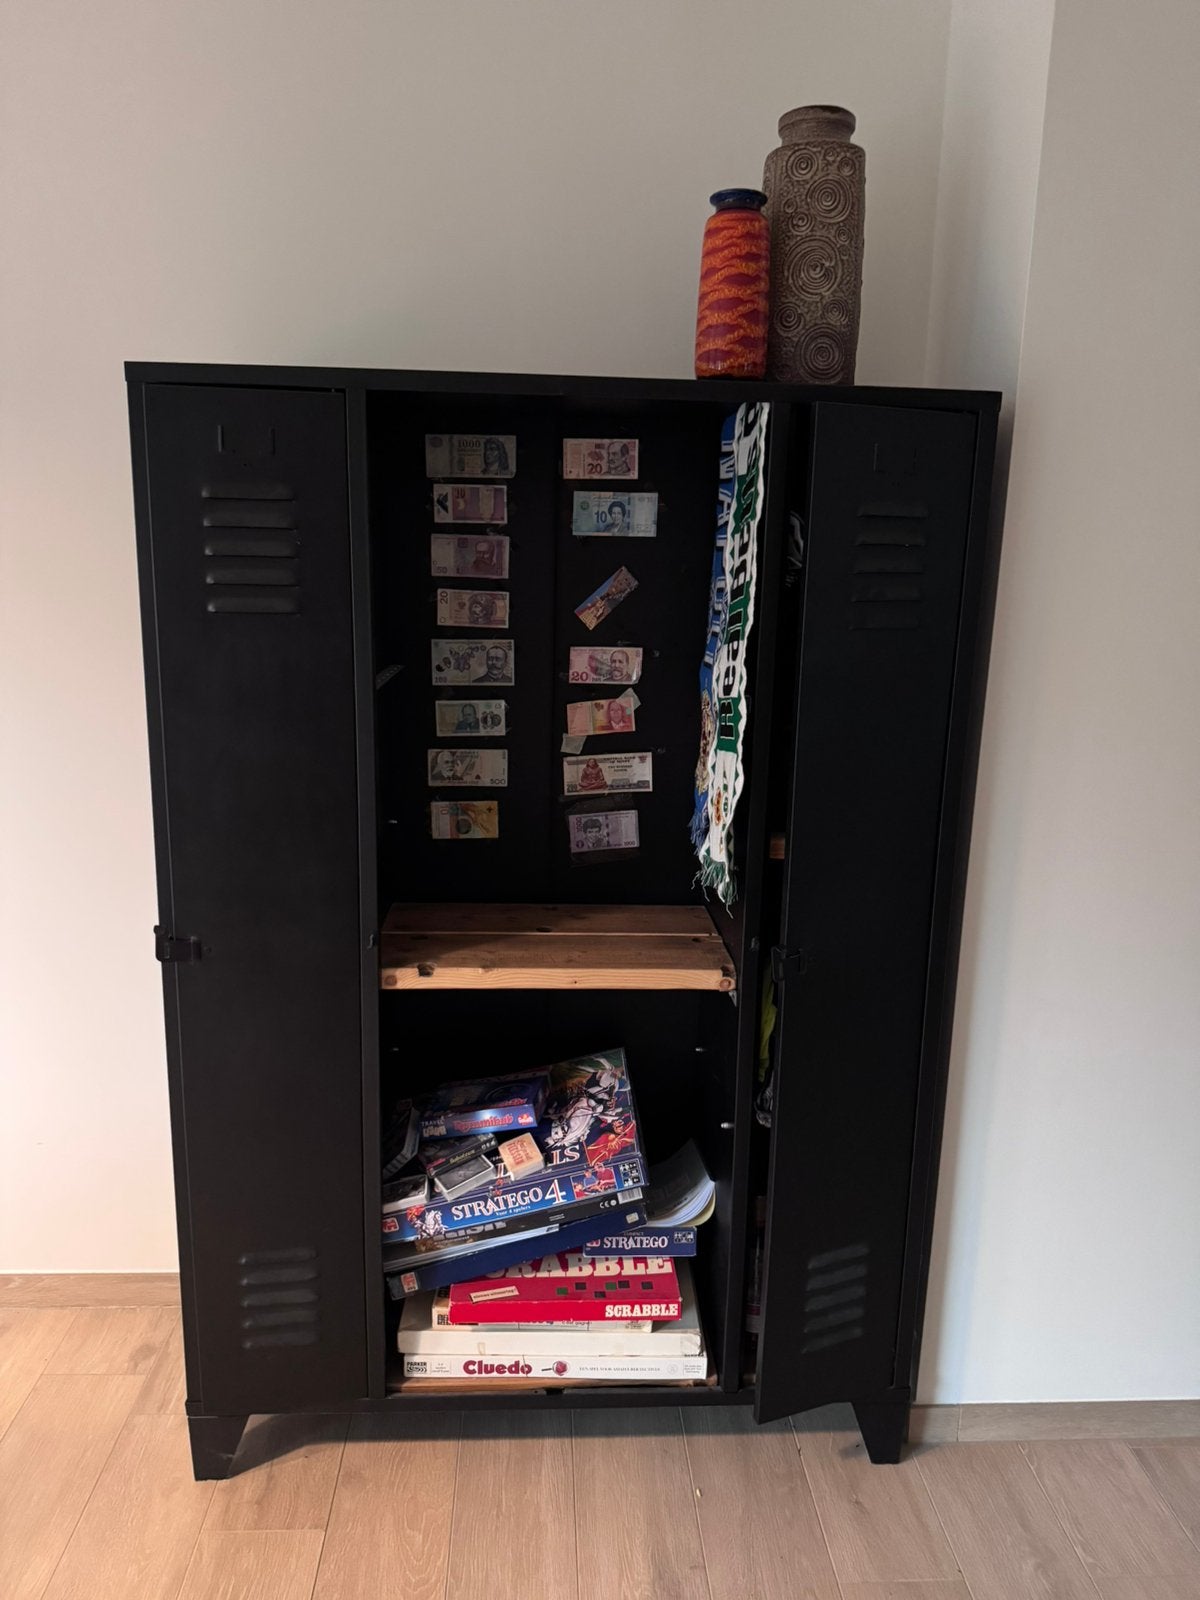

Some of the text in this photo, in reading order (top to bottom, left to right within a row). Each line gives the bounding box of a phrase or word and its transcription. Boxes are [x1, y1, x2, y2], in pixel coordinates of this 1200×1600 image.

[457, 440, 482, 449] 1000
[586, 463, 603, 475] 20
[594, 510, 608, 524] 10
[439, 590, 449, 605] 20
[570, 670, 589, 682] 20
[718, 608, 744, 740] Real
[451, 1179, 568, 1222] STRATEGO 4
[603, 1235, 669, 1250] STRATEGO
[484, 1256, 675, 1277] RABBLE
[605, 1303, 679, 1318] SCRABBLE
[462, 1359, 533, 1375] Cluedo
